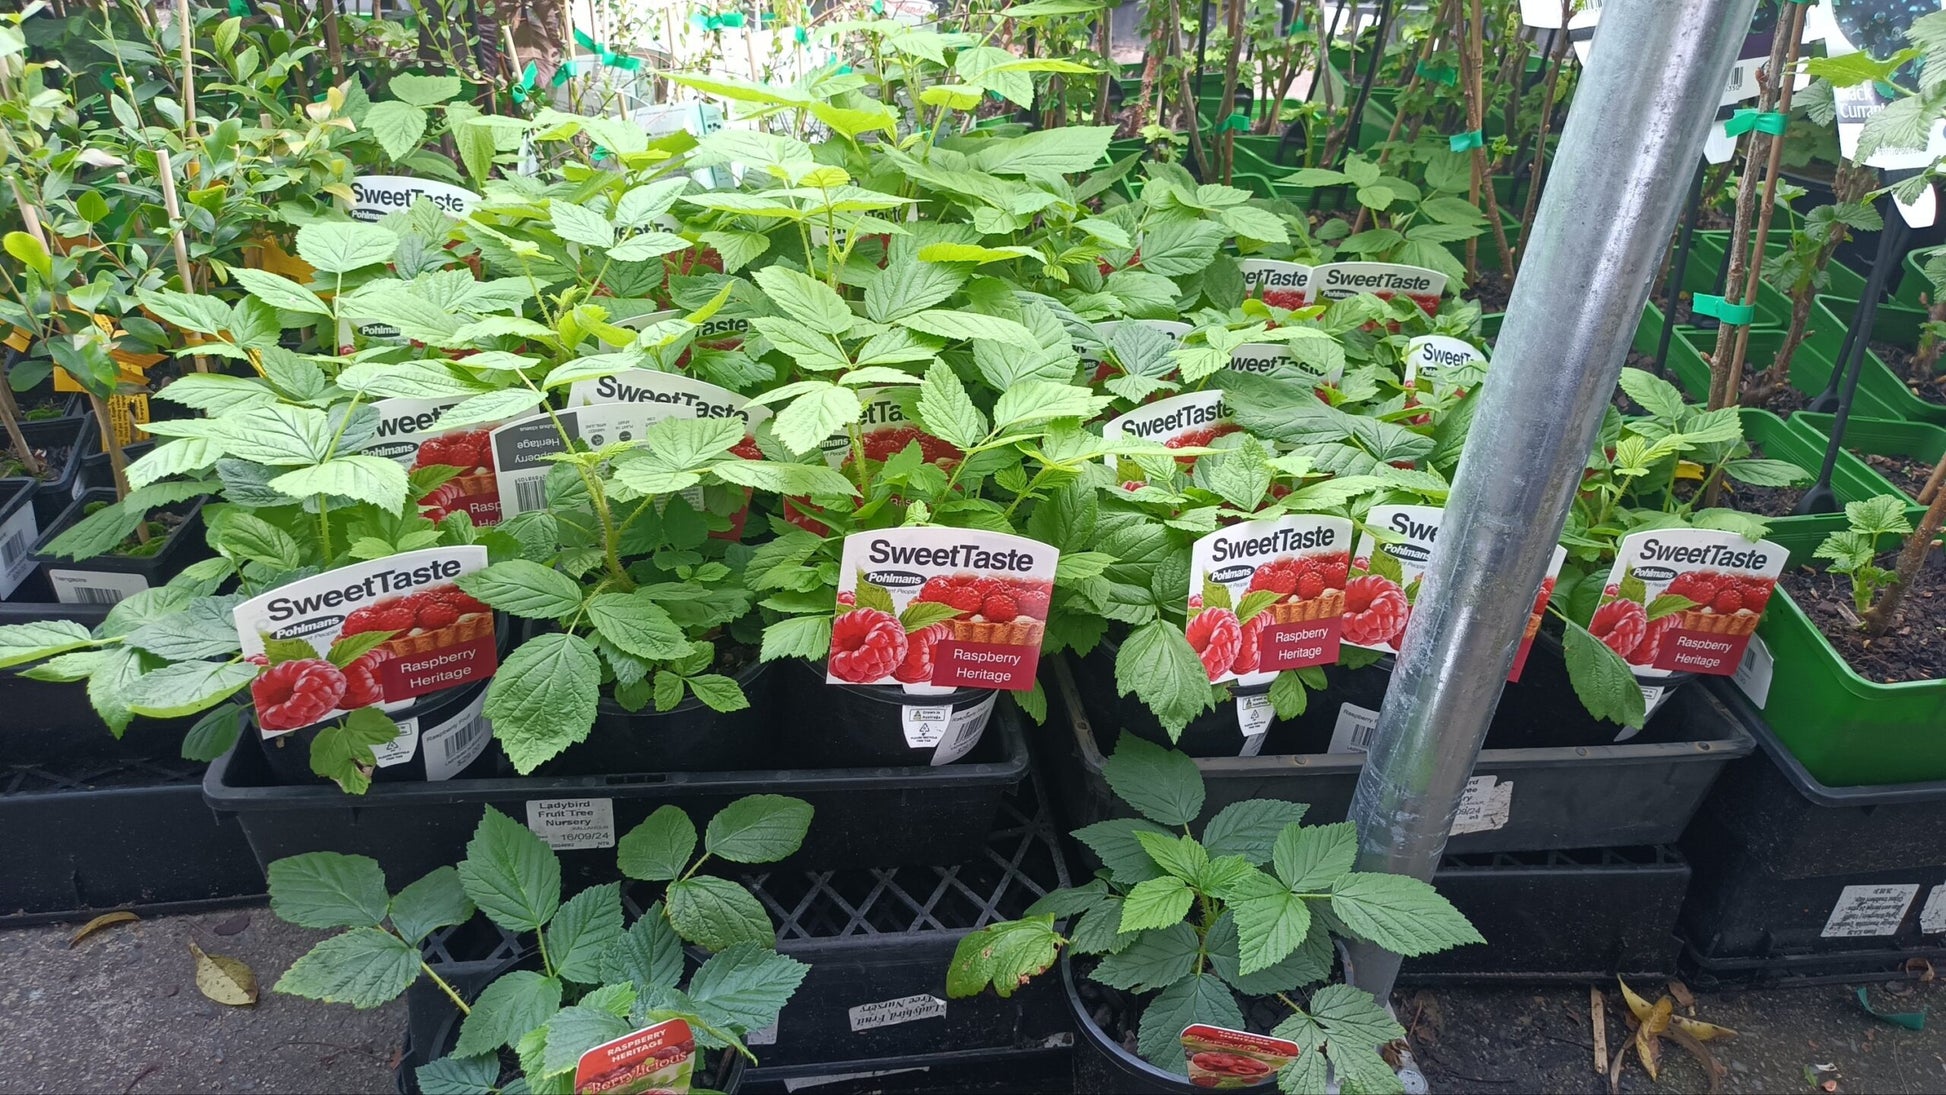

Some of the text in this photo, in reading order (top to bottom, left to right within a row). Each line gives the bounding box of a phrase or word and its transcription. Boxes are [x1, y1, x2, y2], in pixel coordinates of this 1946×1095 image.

[1326, 269, 1431, 290] SweetTaste
[517, 438, 560, 450] Heritage
[1212, 526, 1335, 562] SweetTaste
[869, 539, 1033, 571] SweetTaste
[1640, 538, 1768, 570] SweetTaste
[868, 572, 922, 585] Pohlmans
[1212, 567, 1252, 581] Pohlmans
[1632, 568, 1675, 579] Pohlmans
[267, 559, 462, 622] SweetTaste
[276, 616, 340, 639] Pohlmans
[1275, 627, 1329, 643] Raspberry
[1279, 646, 1322, 661] Heritage
[1677, 636, 1732, 653] Raspberry
[400, 649, 477, 673] Raspberry
[953, 649, 1021, 667] Raspberry
[1674, 653, 1721, 667] Heritage
[409, 665, 472, 688] Heritage
[956, 667, 1011, 683] Heritage
[540, 801, 590, 809] Ladybird
[561, 832, 609, 841] 16/09/24
[856, 1004, 940, 1026] Ladybird Fruit
[860, 999, 906, 1013] Nursery
[607, 1029, 667, 1056] RASPBERRY
[611, 1039, 664, 1063] HERITAGE
[588, 1051, 688, 1094] Berrylicious
